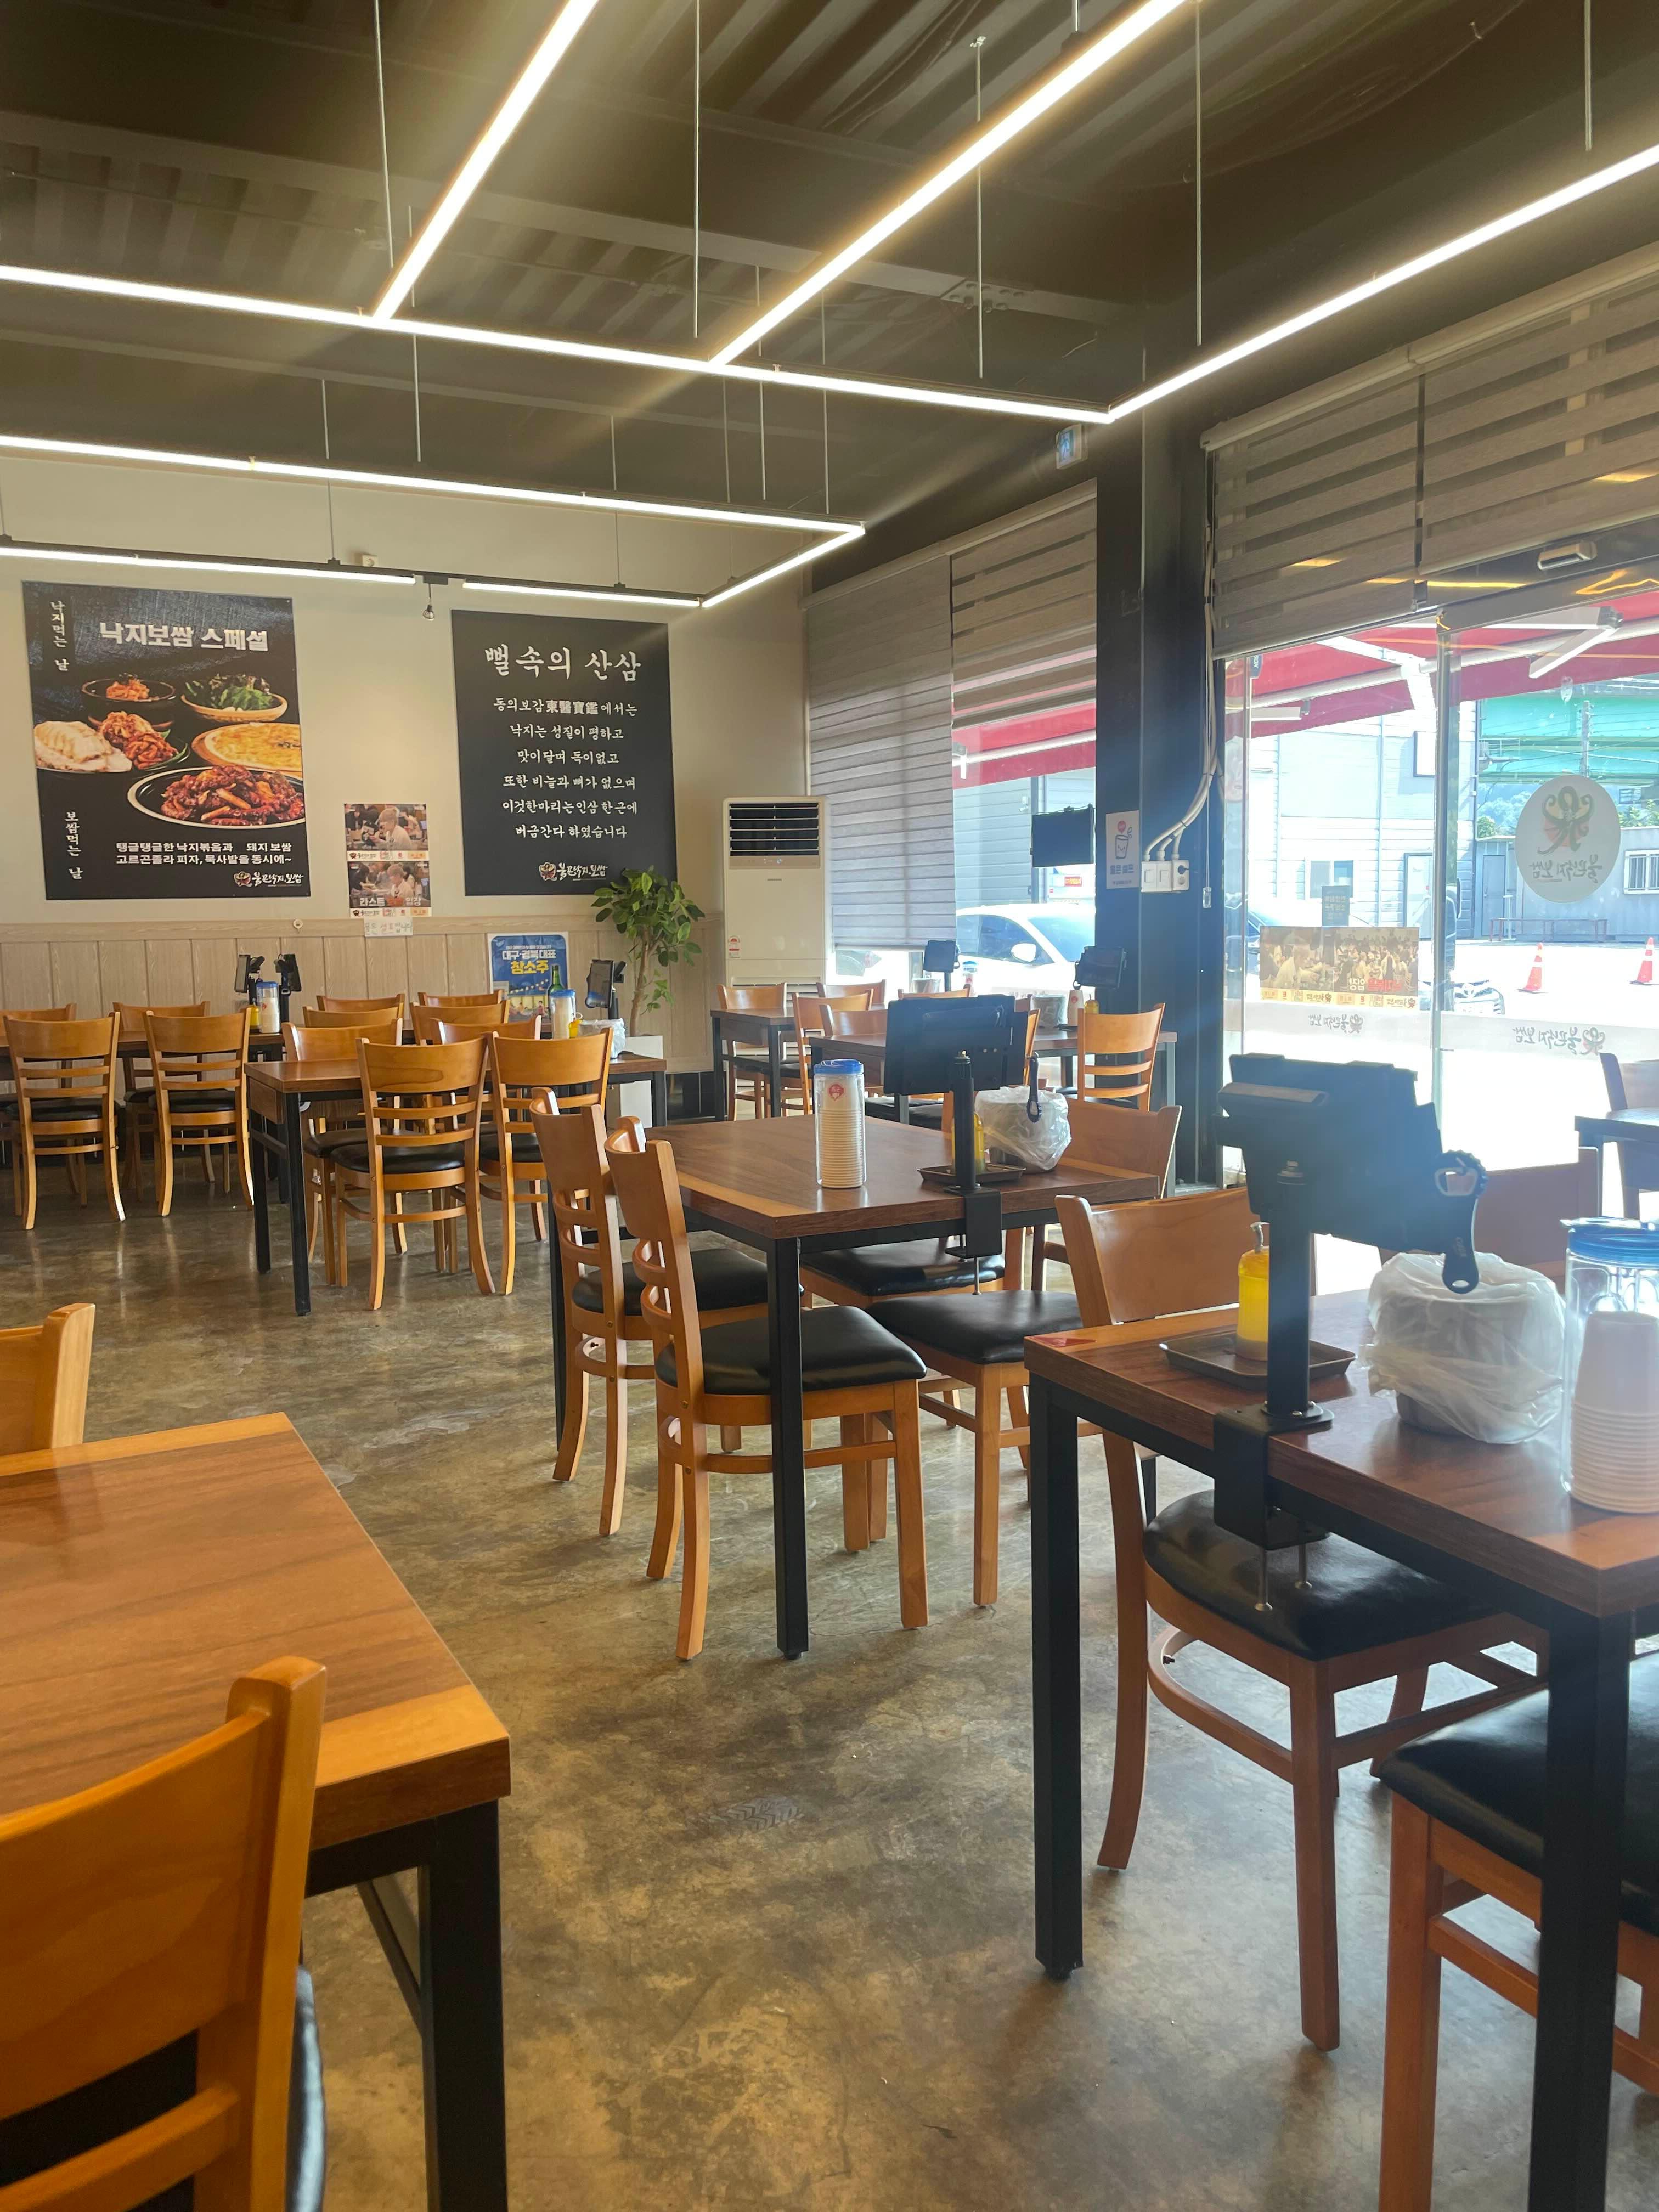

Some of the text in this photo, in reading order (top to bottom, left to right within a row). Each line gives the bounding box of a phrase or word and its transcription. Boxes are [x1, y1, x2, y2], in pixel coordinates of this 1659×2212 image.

[99, 622, 268, 652] 낙지보쌈 스페셜
[54, 658, 70, 672] 날
[584, 649, 641, 682] 산삼
[510, 723, 624, 741] 낙지는 성질이 평하고
[503, 774, 635, 791] 또한 비늘과 뼈가 없으며
[515, 824, 628, 839] 버금간다 하였습니다
[176, 842, 233, 853] 낙지볶음과
[246, 842, 268, 853] 돼지
[270, 842, 292, 853] 보쌈
[205, 854, 250, 865] 묵사발을
[69, 867, 83, 879] 날
[510, 960, 549, 975] 참소주
